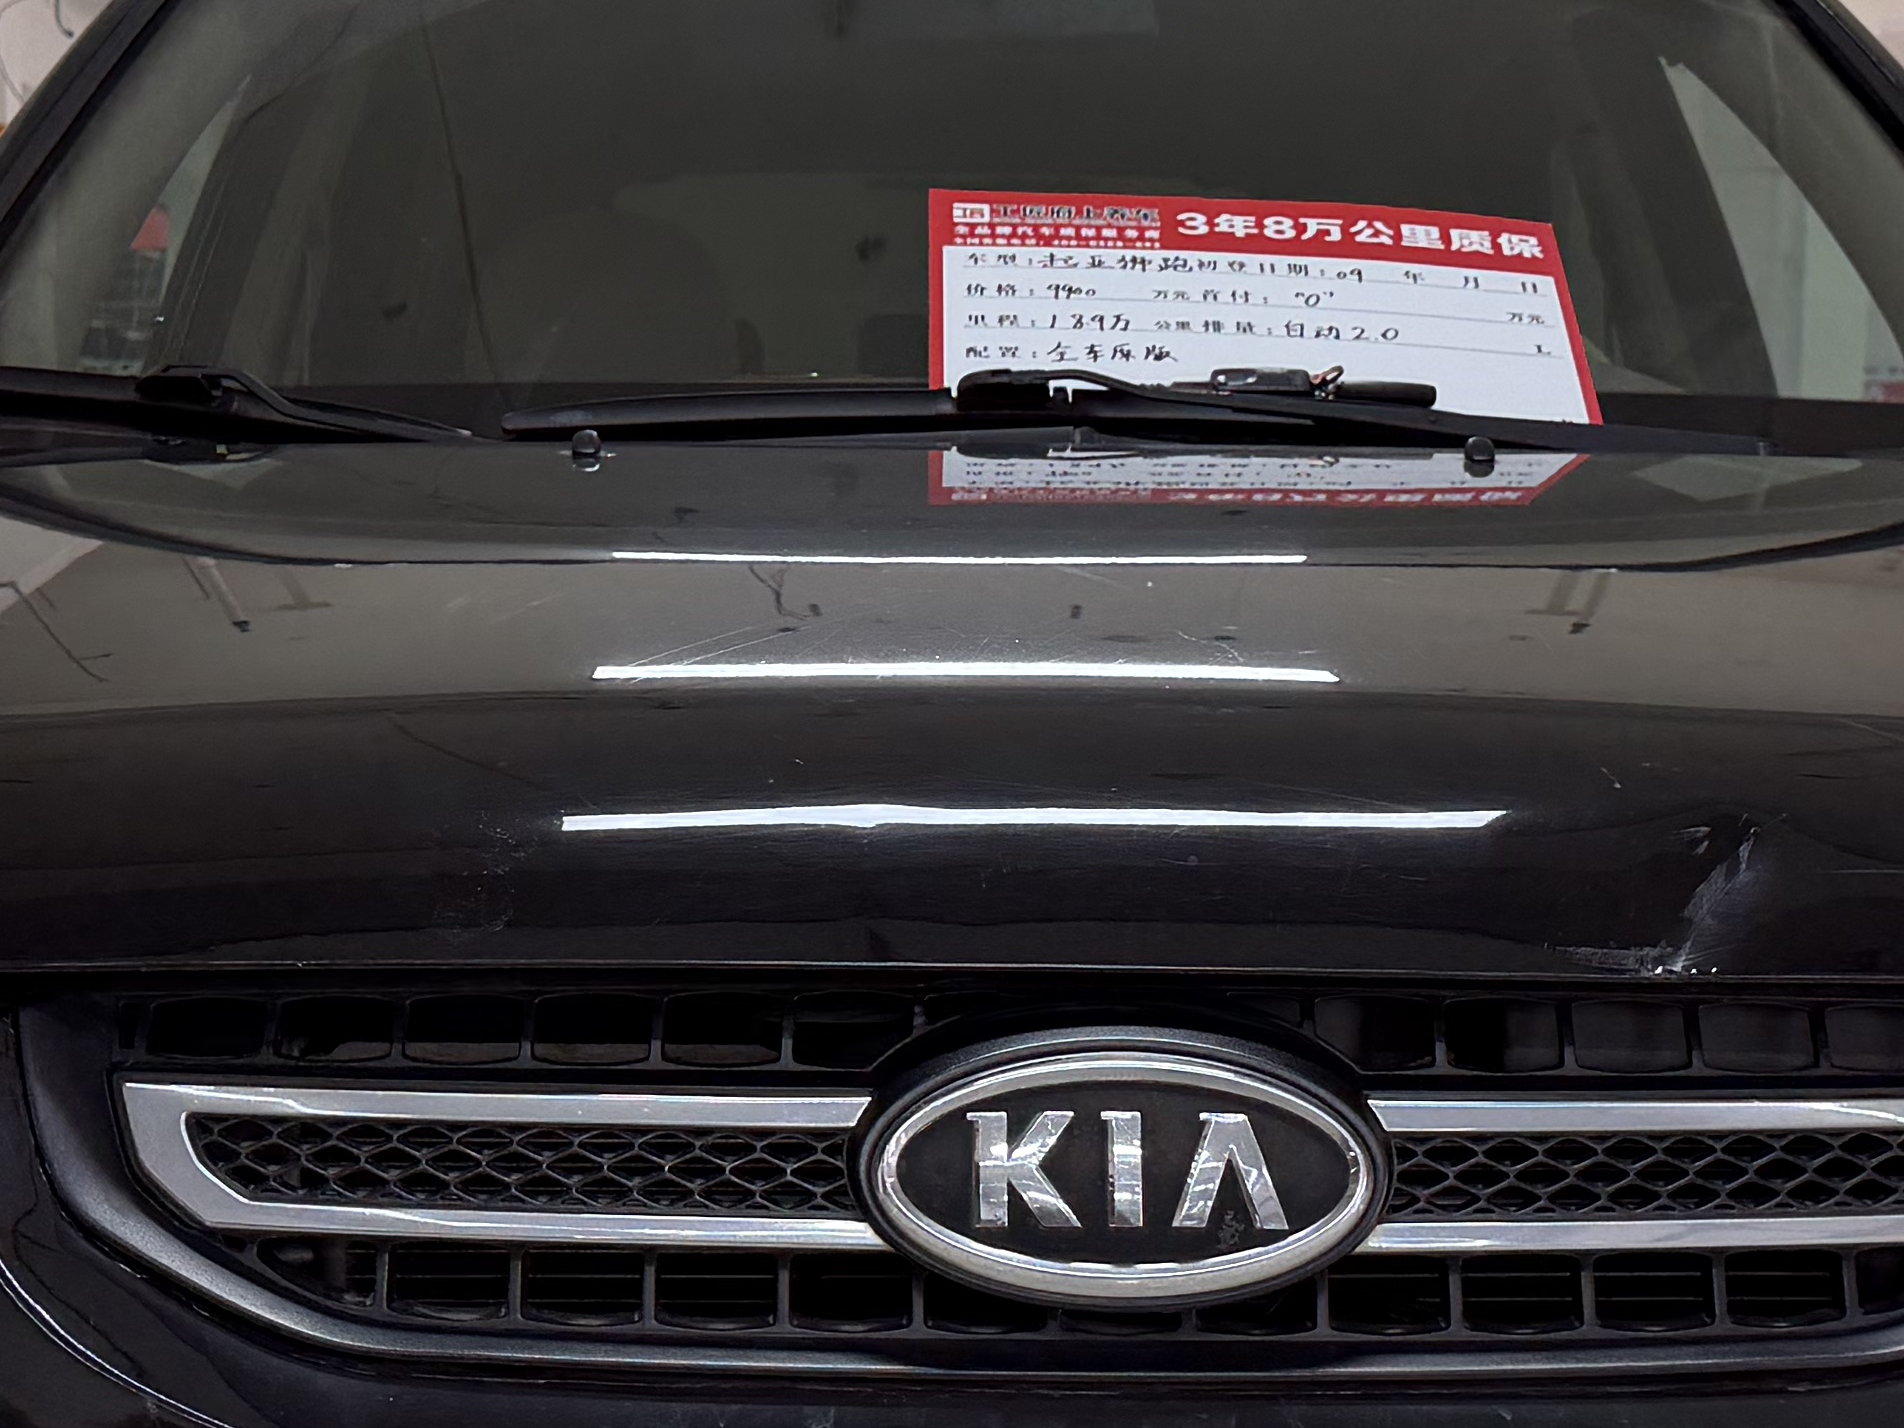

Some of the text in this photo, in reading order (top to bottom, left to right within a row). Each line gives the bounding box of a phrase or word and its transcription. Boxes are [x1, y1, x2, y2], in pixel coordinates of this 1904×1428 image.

[1177, 212, 1545, 259] 3年8万公里质保
[965, 1110, 1289, 1229] KIA
